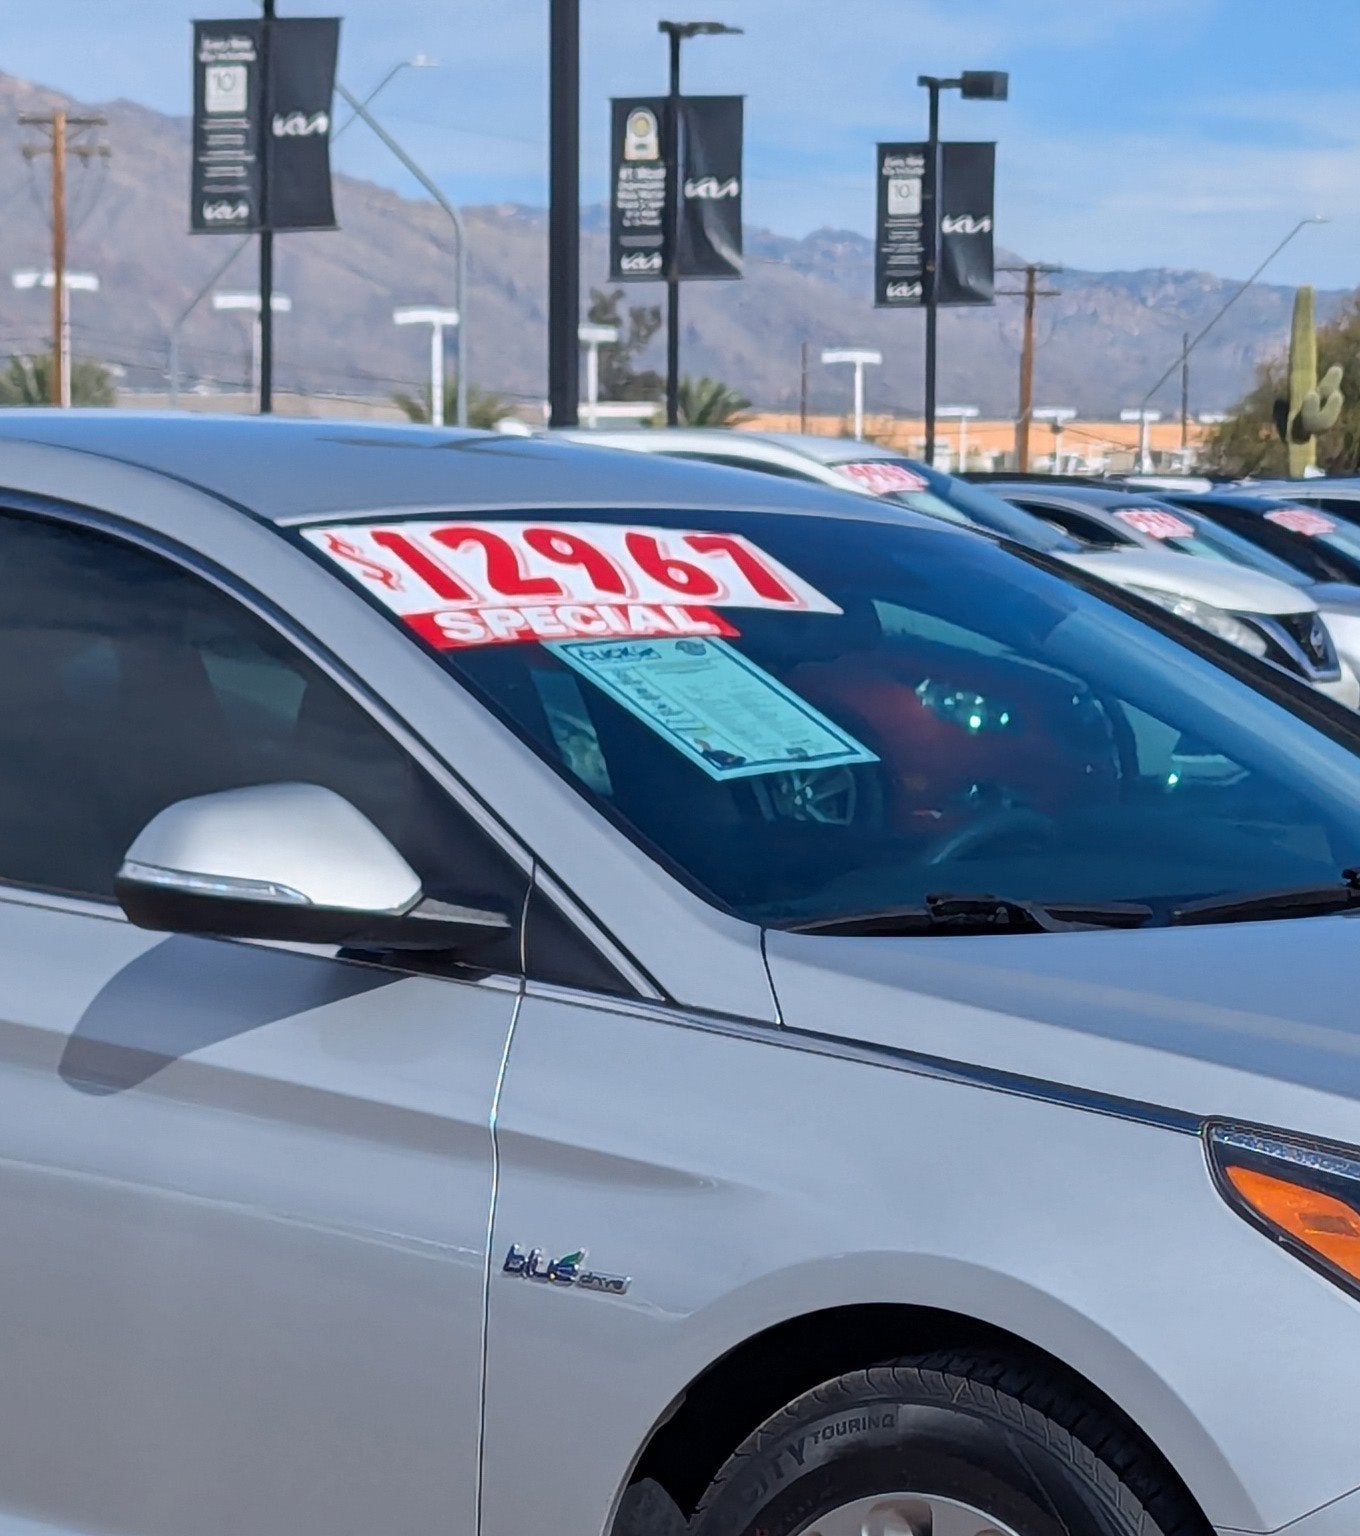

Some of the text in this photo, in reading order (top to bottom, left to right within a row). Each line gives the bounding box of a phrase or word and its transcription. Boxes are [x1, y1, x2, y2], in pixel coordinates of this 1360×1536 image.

[323, 525, 802, 604] $12967
[433, 604, 721, 641] SPECIAL
[502, 1243, 580, 1283] blue
[811, 1412, 898, 1446] TOURING
